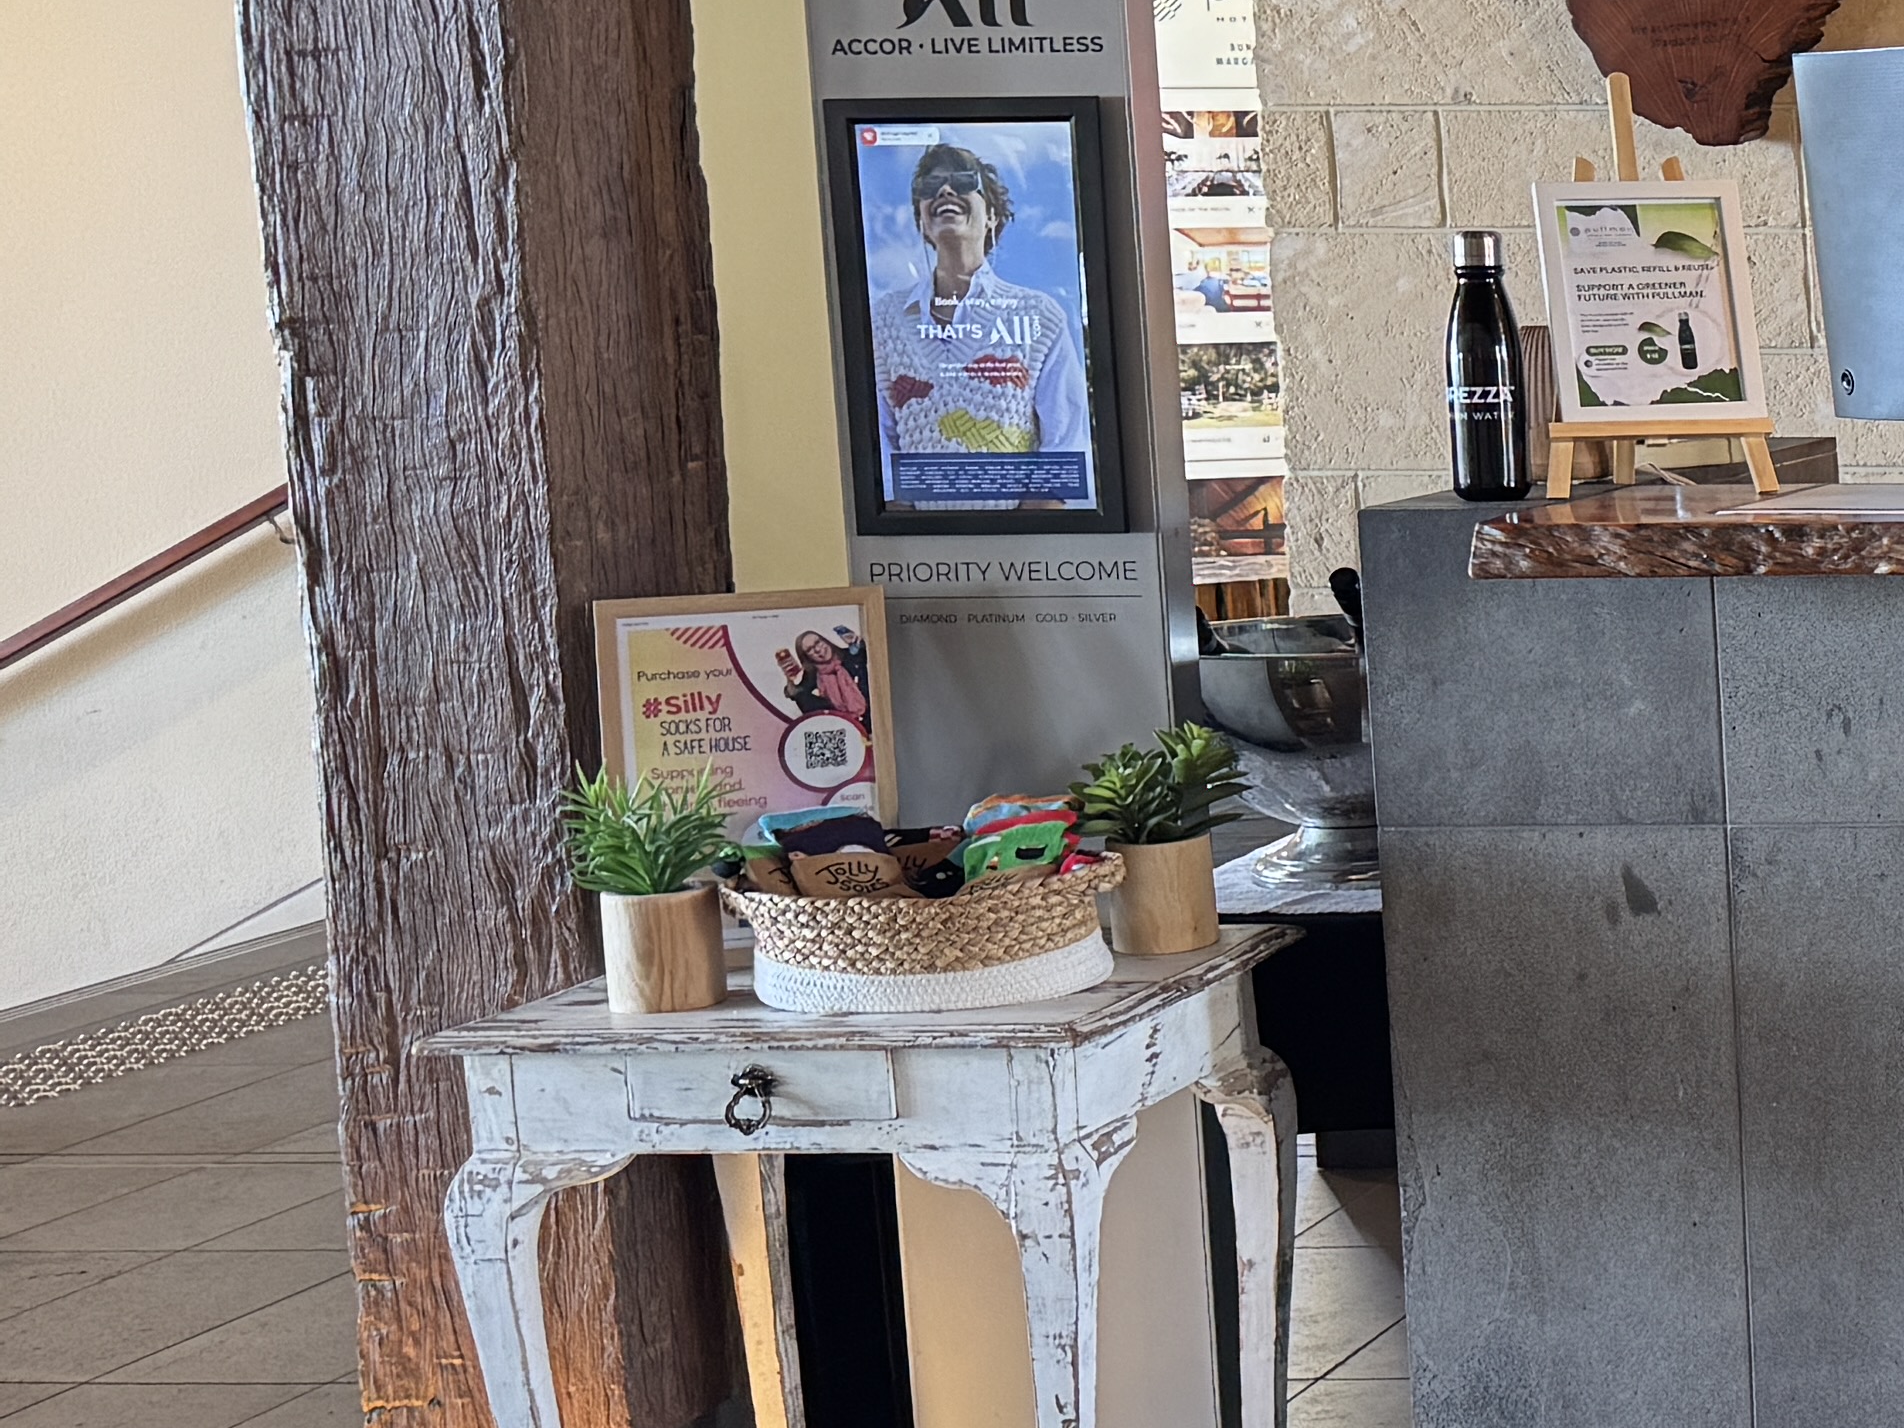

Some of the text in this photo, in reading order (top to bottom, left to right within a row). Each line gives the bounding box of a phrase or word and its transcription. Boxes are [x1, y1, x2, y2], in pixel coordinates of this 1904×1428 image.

[832, 36, 1104, 55] ACCOR LIVE LIMITLESS
[1576, 281, 1687, 293] SUPPORT A GREENER
[1577, 292, 1619, 303] FUTURE
[1621, 291, 1650, 301] WITH
[917, 324, 983, 339] THAT'S
[869, 560, 1138, 583] PRIORITY WELCOME
[899, 612, 1117, 624] DIAMOND PLATINUM GOLD SILVER
[637, 667, 732, 682] Purchase your
[642, 691, 722, 719] #Silly
[660, 716, 732, 737] SOCKS FOR
[662, 735, 752, 757] A SAFE HOUSE
